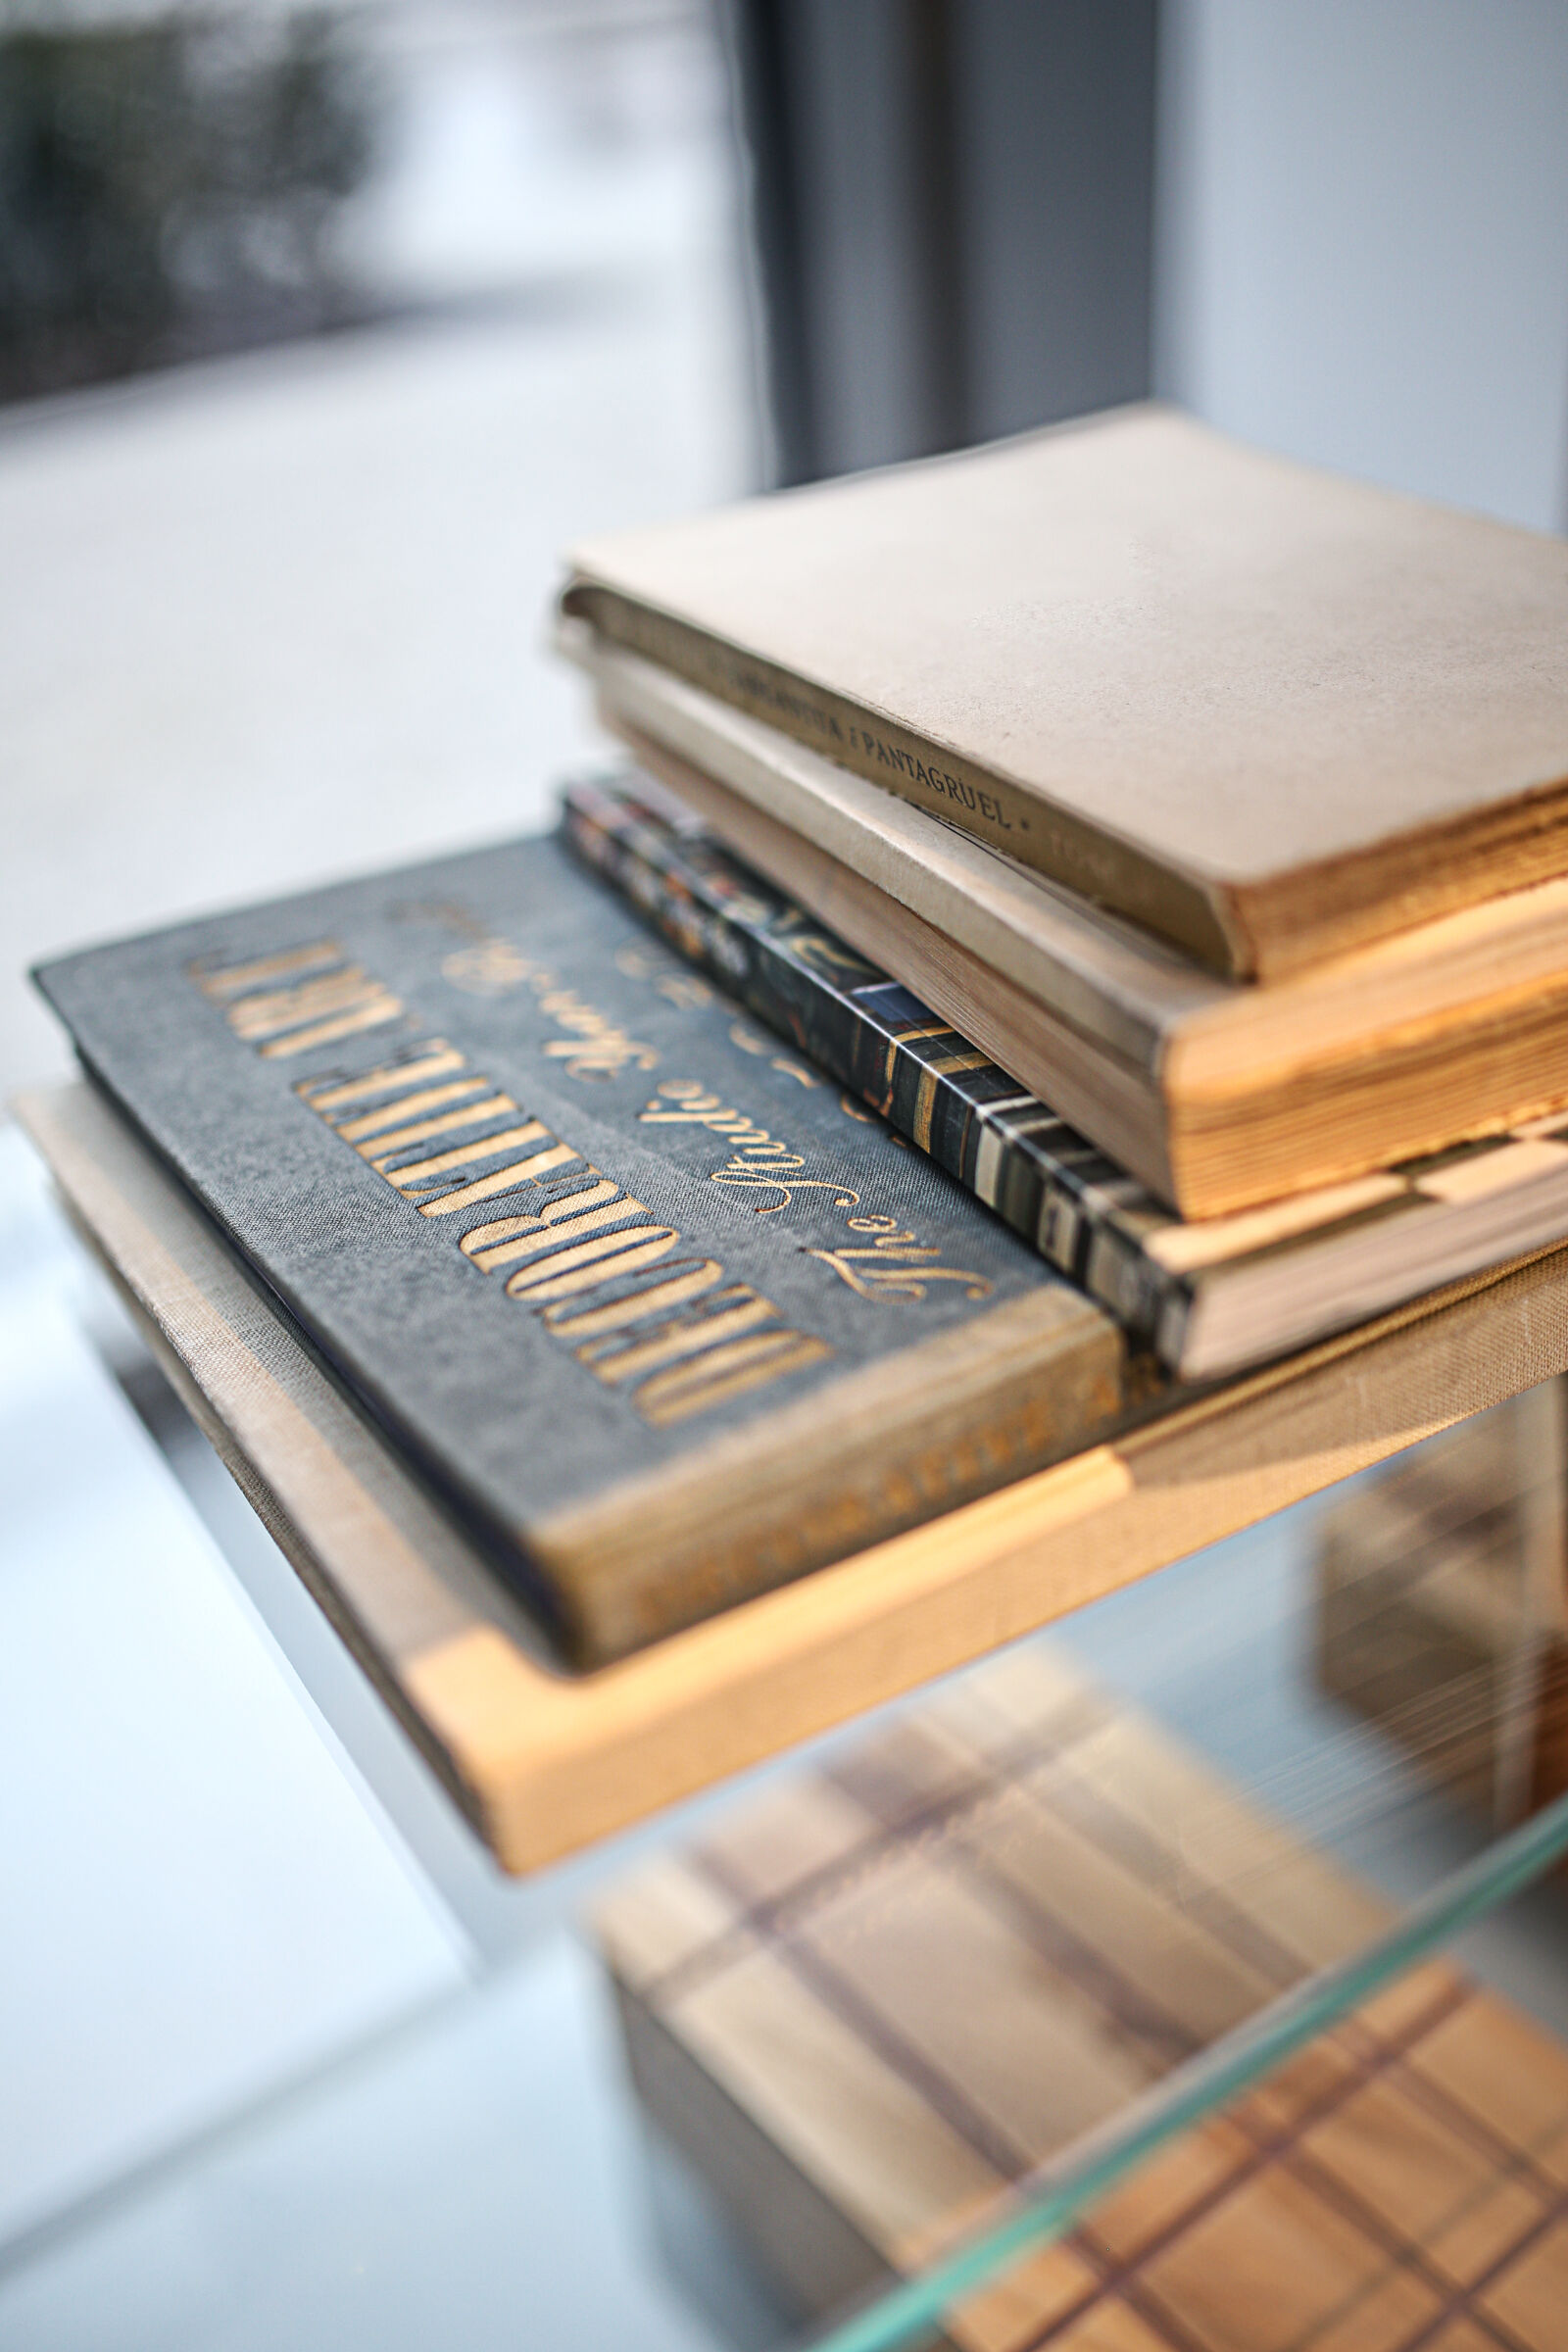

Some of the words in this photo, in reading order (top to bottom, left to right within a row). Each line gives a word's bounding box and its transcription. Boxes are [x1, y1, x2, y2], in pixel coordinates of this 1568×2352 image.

[860, 730, 1011, 830] PANTAGRUEL
[184, 938, 422, 1058] ART
[635, 1079, 860, 1214] Studio
[292, 1037, 835, 1432] DECORATIVE
[798, 1213, 995, 1305] The
